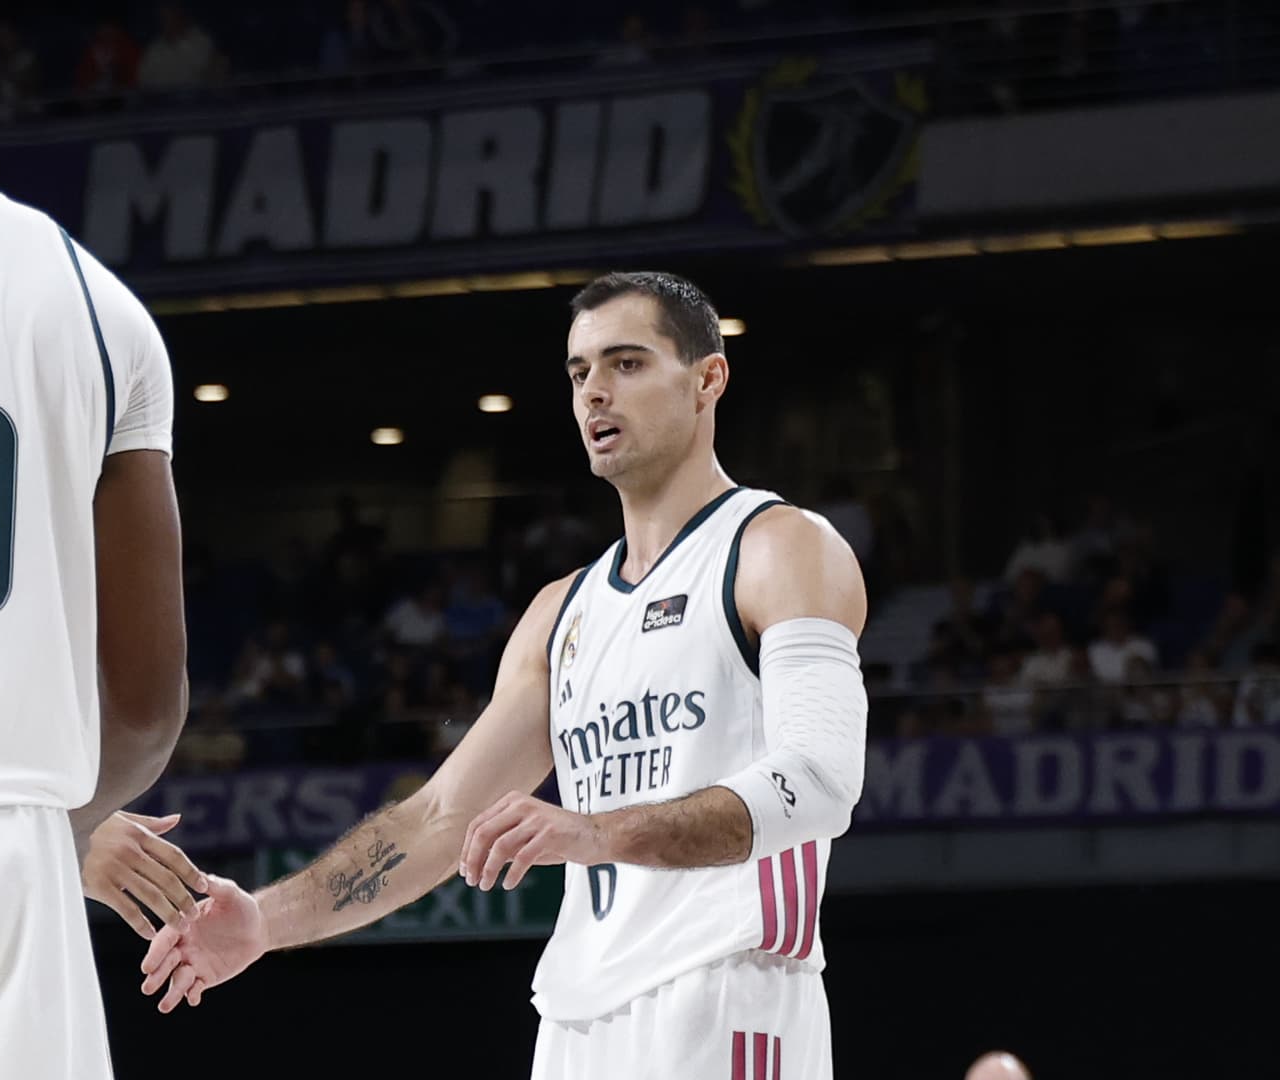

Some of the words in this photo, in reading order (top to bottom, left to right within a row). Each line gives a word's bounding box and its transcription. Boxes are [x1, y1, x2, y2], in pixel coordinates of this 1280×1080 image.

[81, 89, 713, 268] MADRID
[559, 691, 706, 769] miates
[162, 770, 367, 848] ERS
[600, 746, 672, 797] ETTER
[853, 733, 1280, 818] MADRID
[384, 873, 538, 926] XIT
